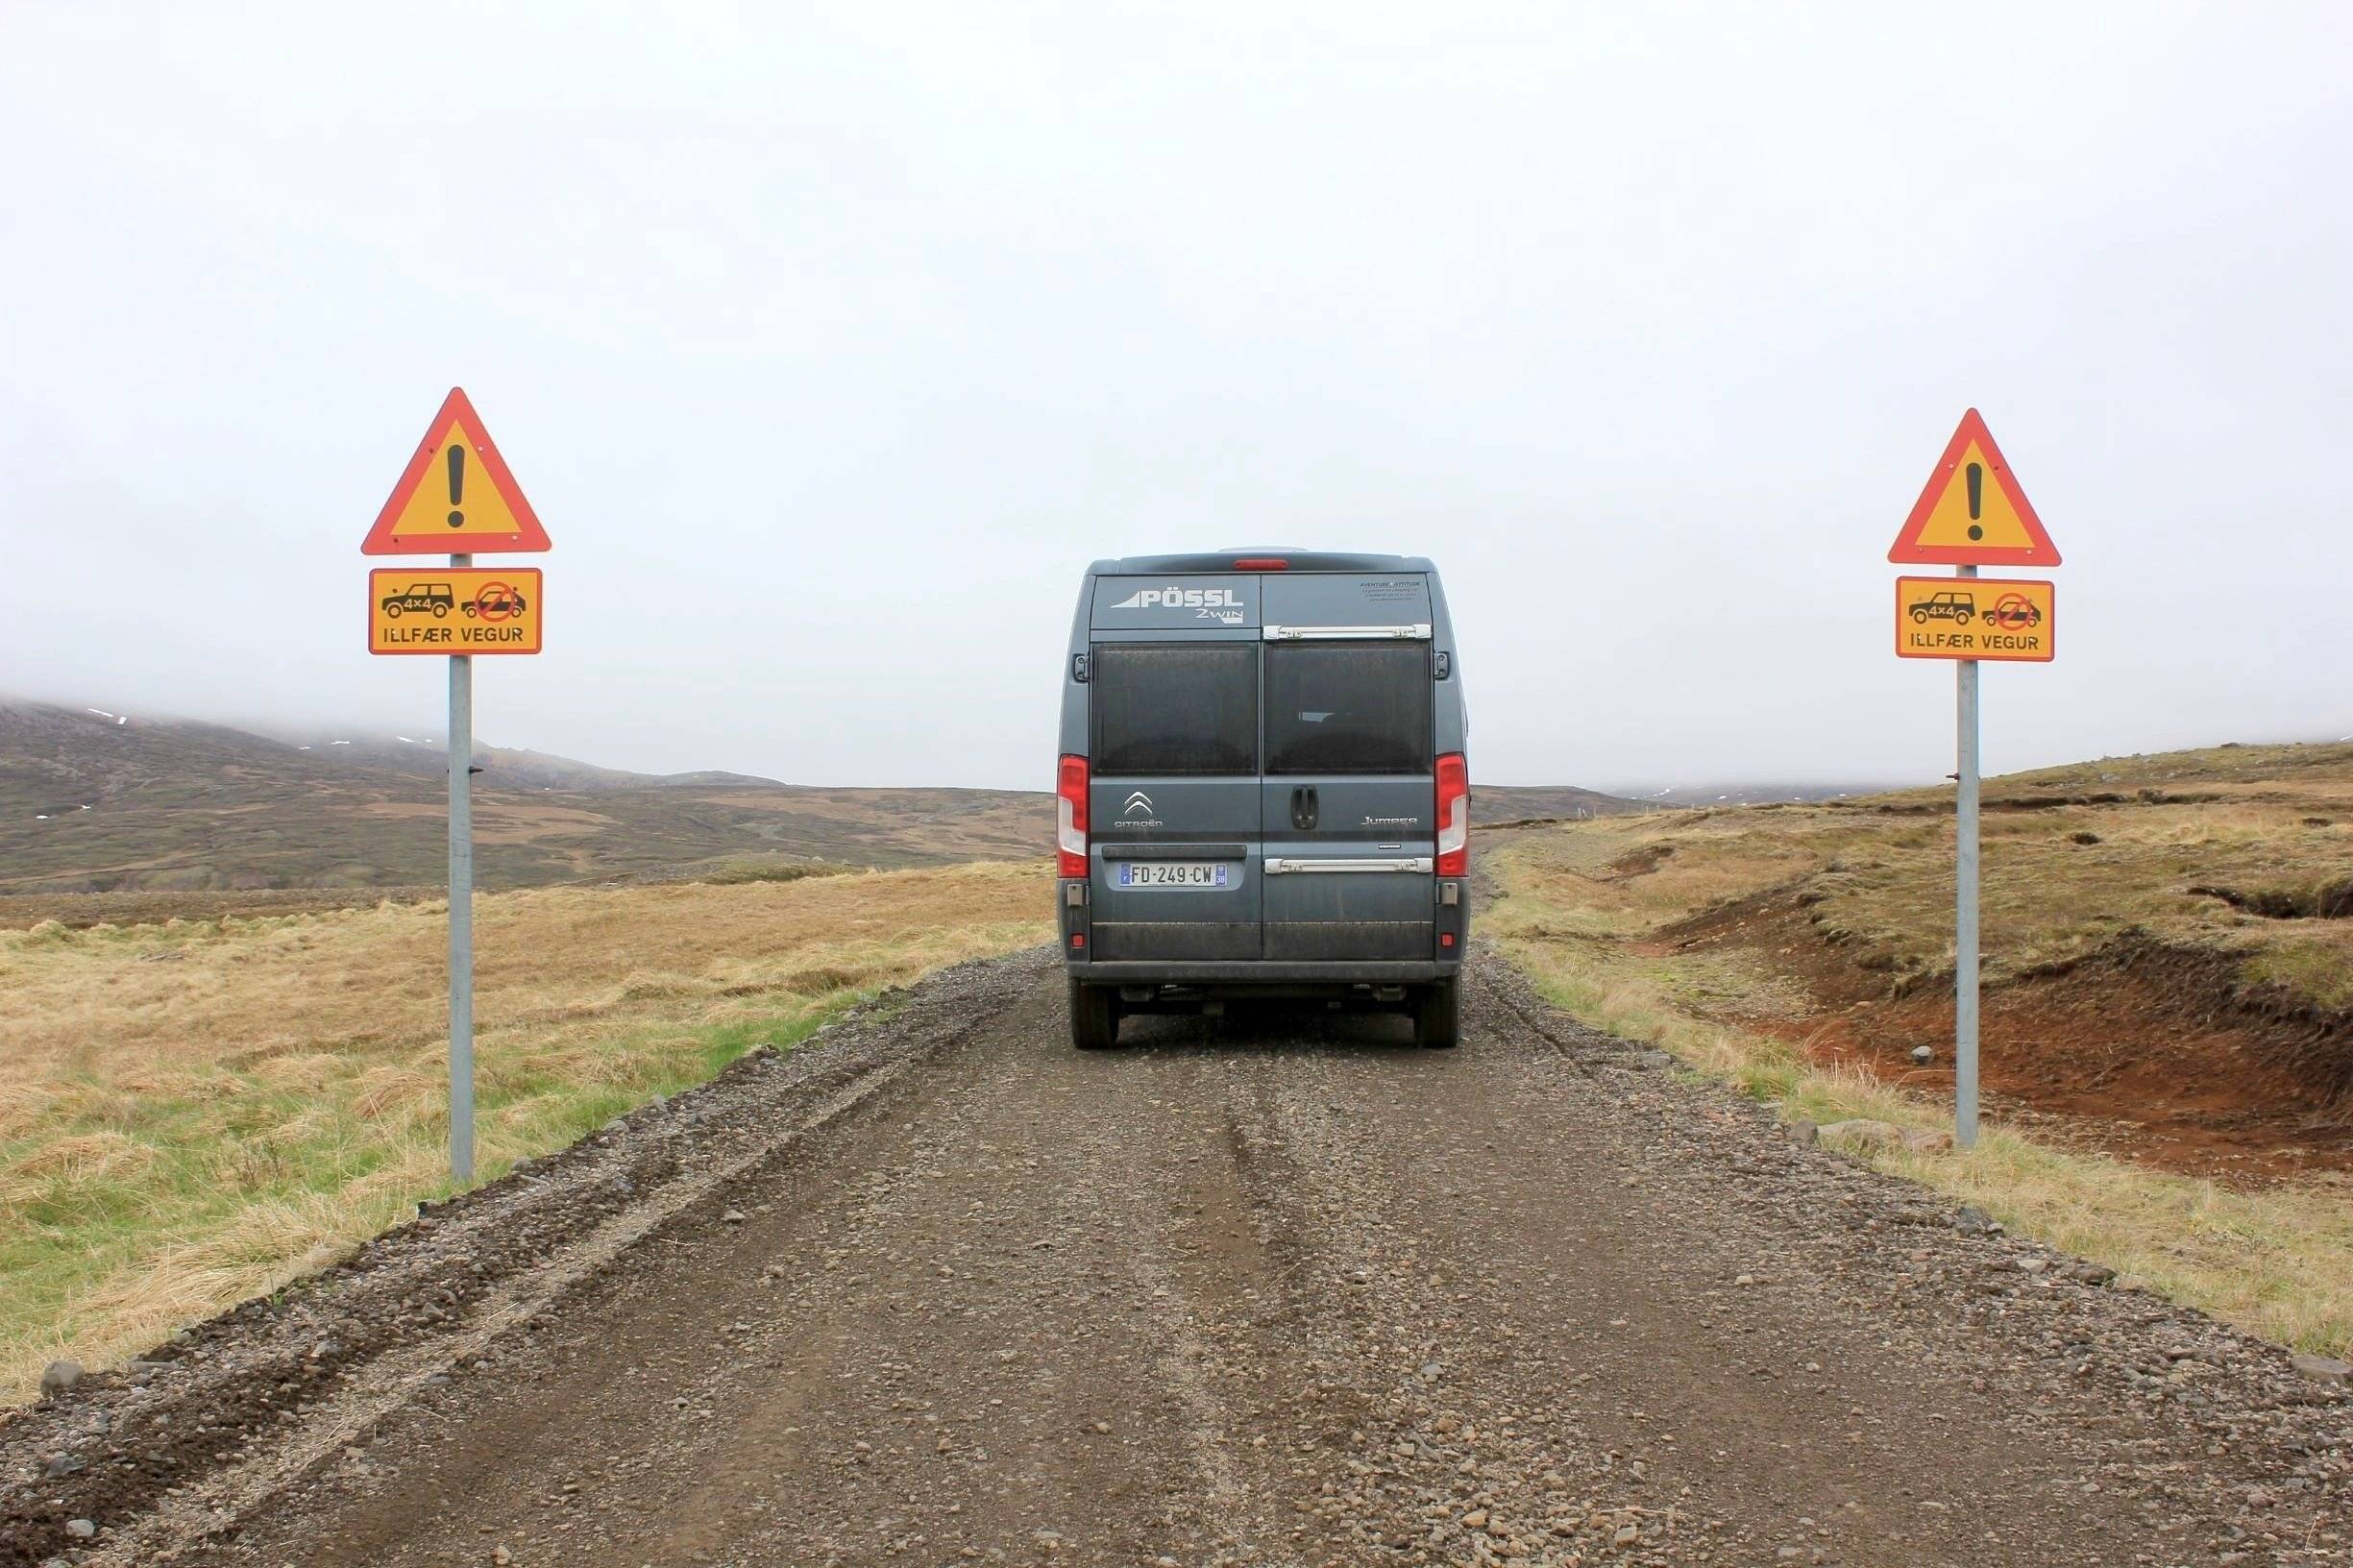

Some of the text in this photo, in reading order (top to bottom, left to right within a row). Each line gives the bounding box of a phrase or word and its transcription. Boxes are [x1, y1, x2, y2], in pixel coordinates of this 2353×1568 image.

[1140, 586, 1244, 607] PÖSSL
[383, 627, 524, 643] ILLFÆR VEGUR
[1910, 632, 2039, 649] ILLFÆR VEGUR
[1216, 874, 1225, 884] 38
